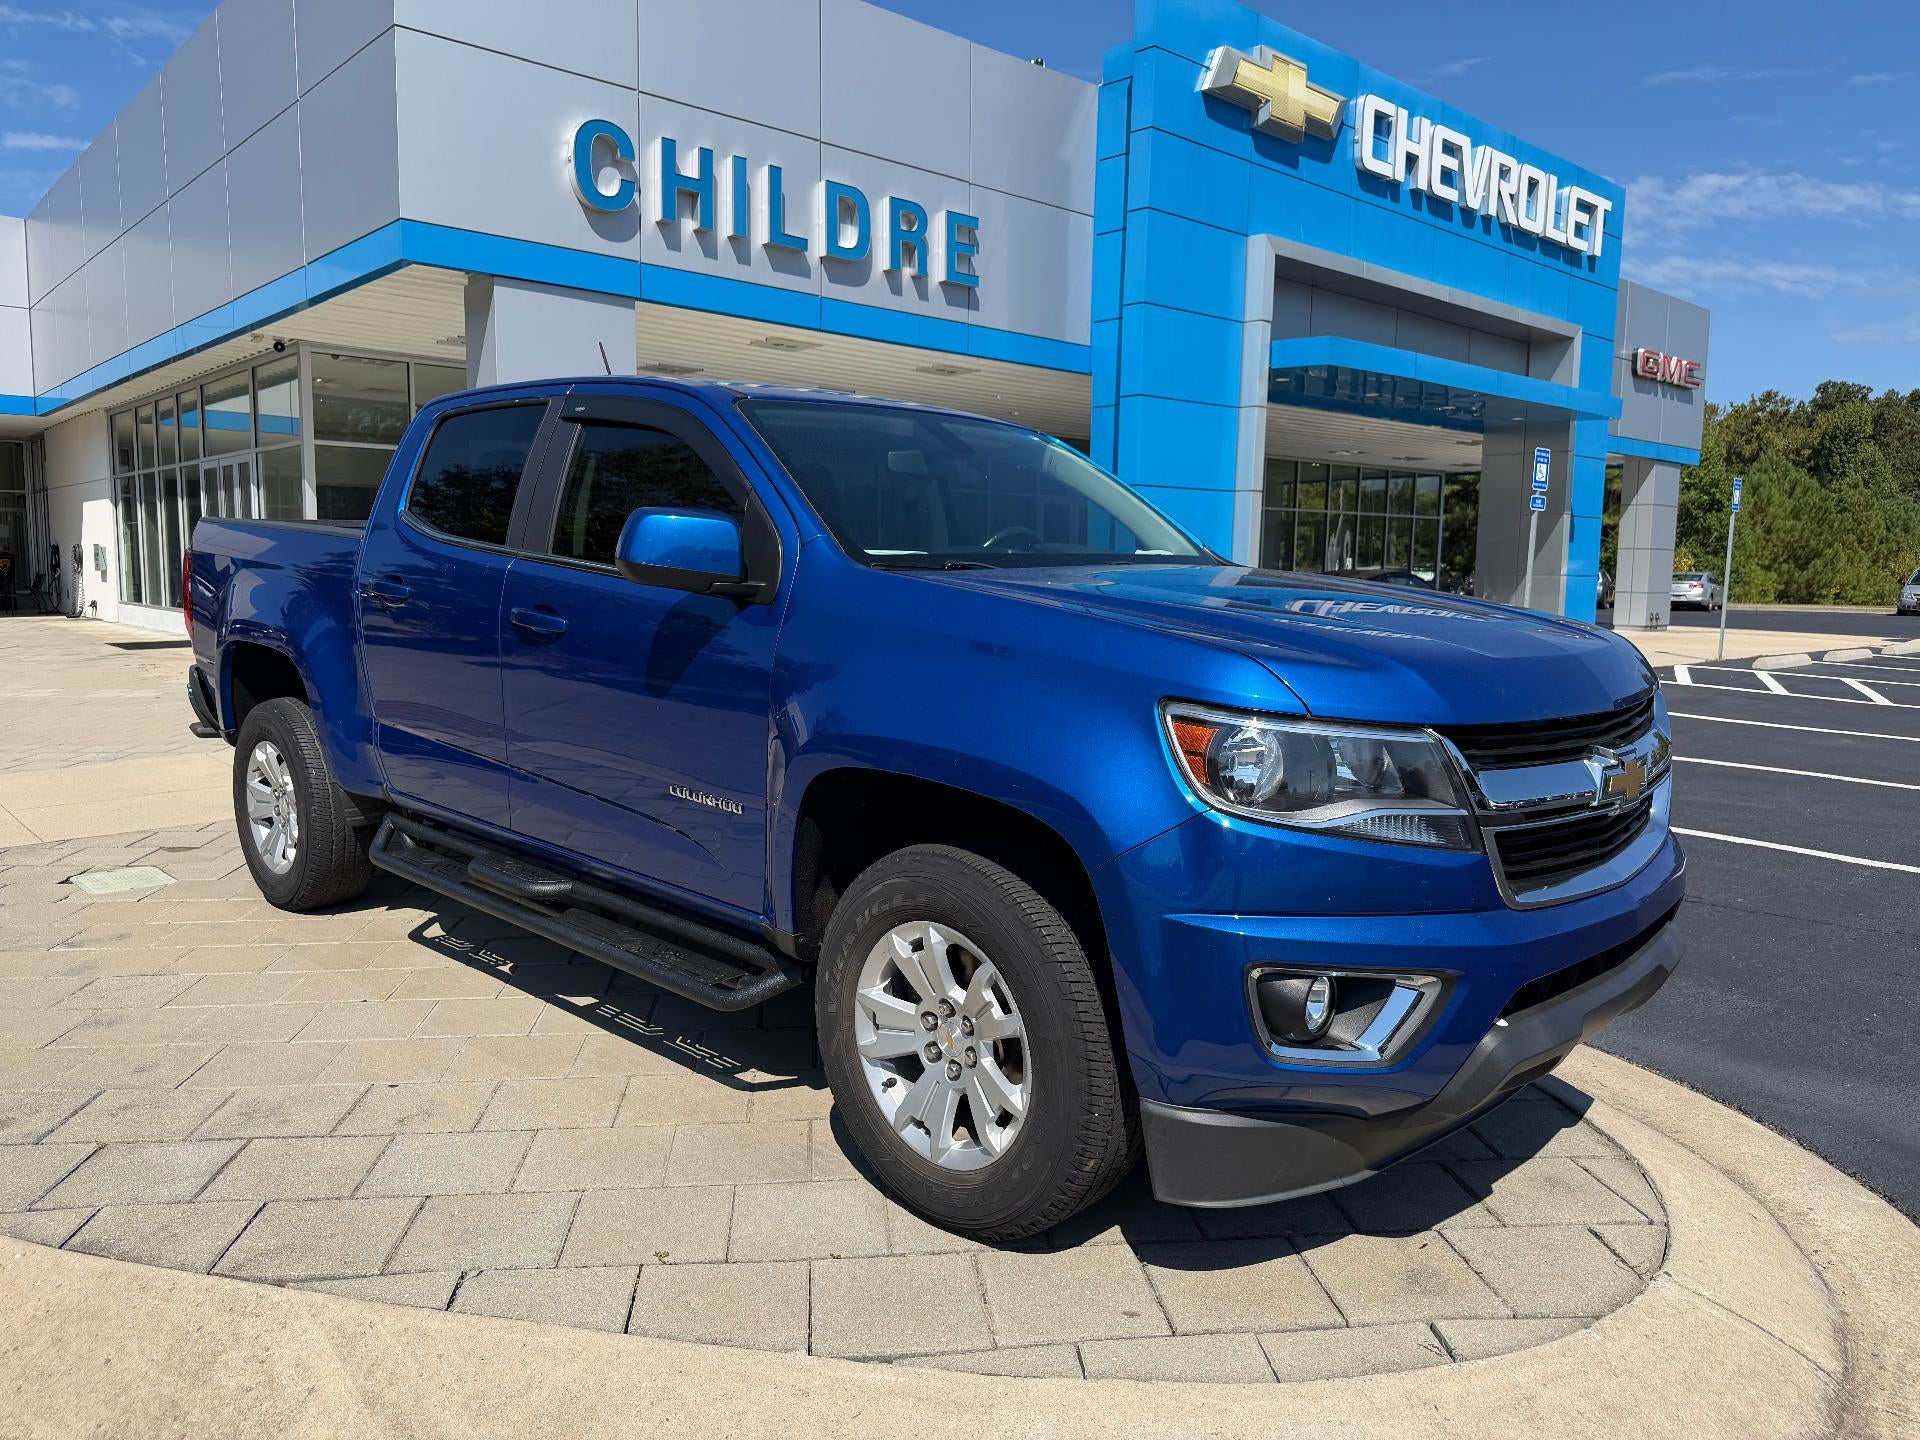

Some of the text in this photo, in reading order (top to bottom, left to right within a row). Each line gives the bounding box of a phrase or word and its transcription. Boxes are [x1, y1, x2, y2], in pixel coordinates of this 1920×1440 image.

[570, 118, 980, 288] CHILDRE
[1354, 94, 1612, 257] CHEVROLET
[1637, 348, 1702, 389] GMC
[669, 784, 744, 815] COLORADO
